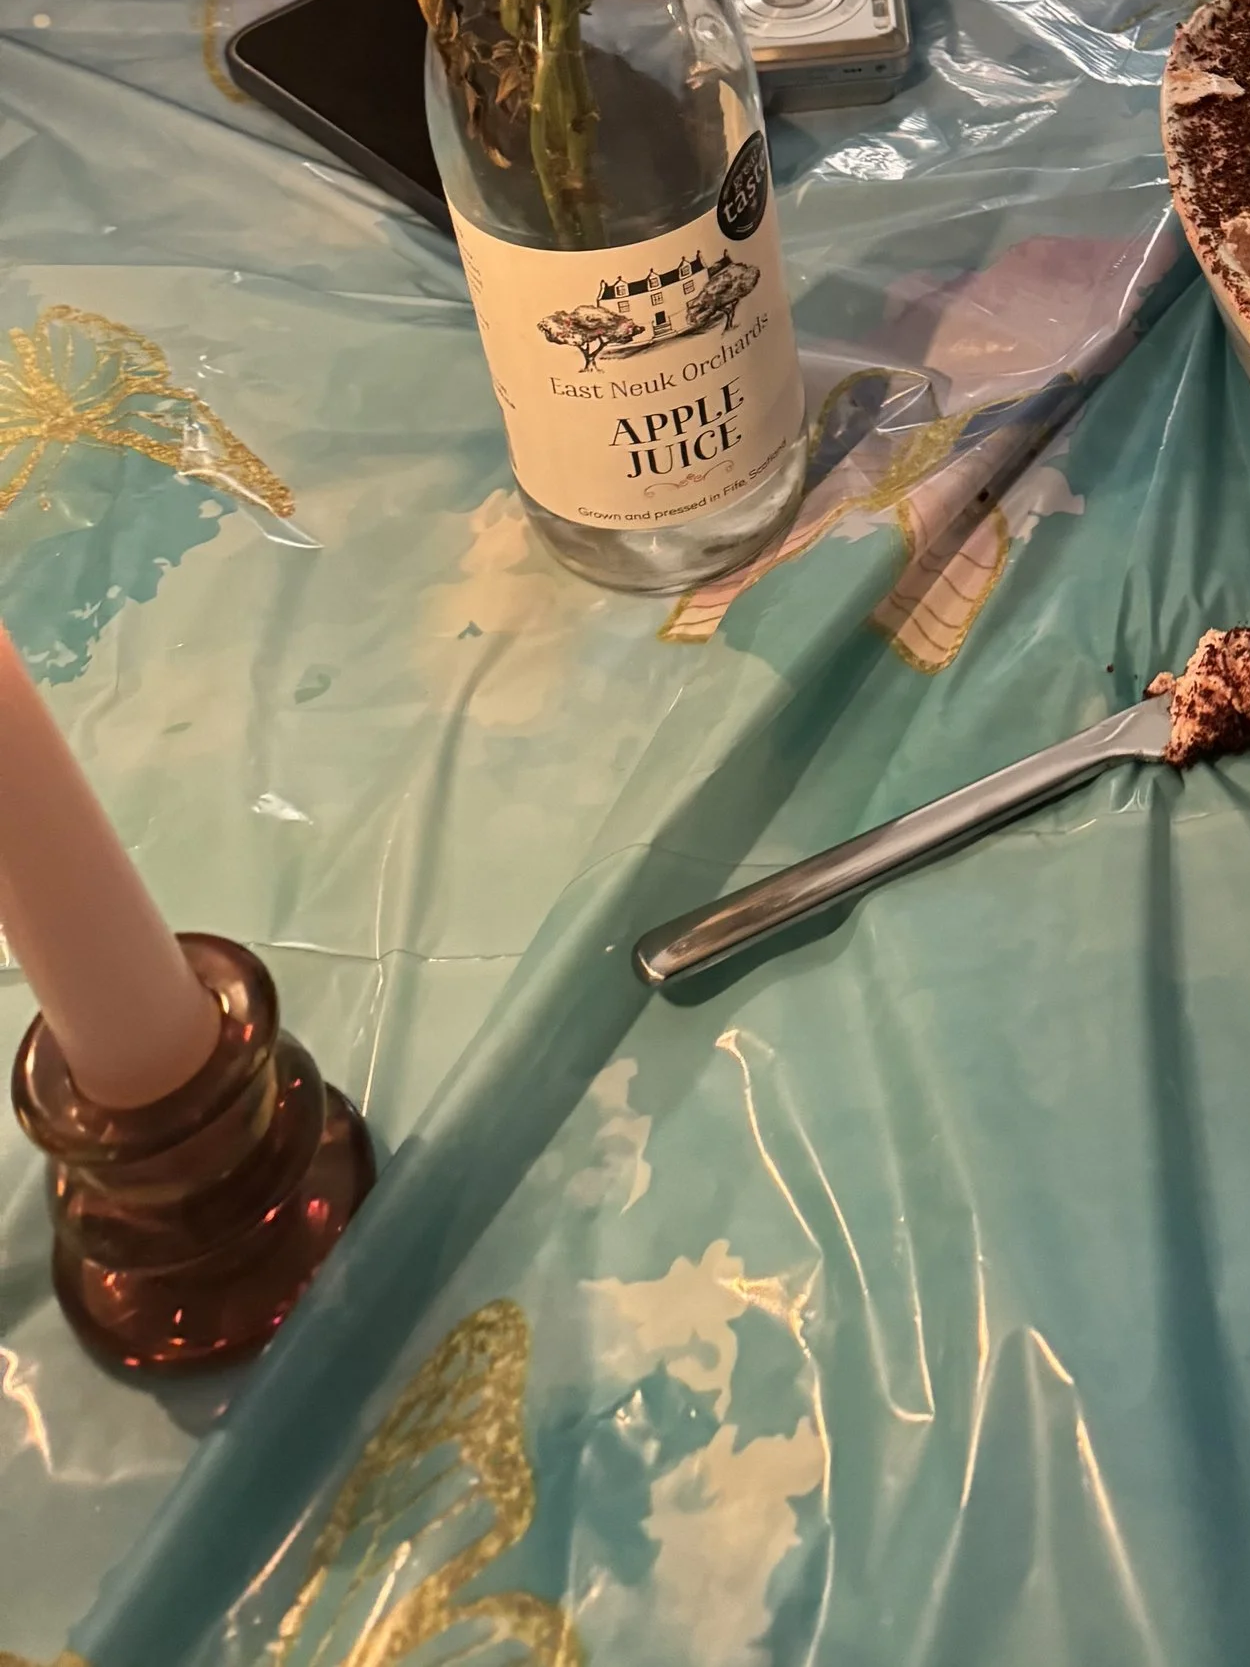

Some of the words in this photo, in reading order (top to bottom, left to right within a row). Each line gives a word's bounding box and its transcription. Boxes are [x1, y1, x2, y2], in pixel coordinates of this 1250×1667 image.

[550, 376, 604, 399] East
[610, 372, 678, 399] Neuk
[682, 312, 769, 382] Orchards
[608, 376, 745, 447] APPLE
[627, 414, 743, 478] JUICE
[578, 506, 622, 521] Grown
[624, 510, 651, 521] and
[654, 497, 707, 520] pressed
[709, 491, 721, 503] in
[749, 437, 787, 480] Scotland
